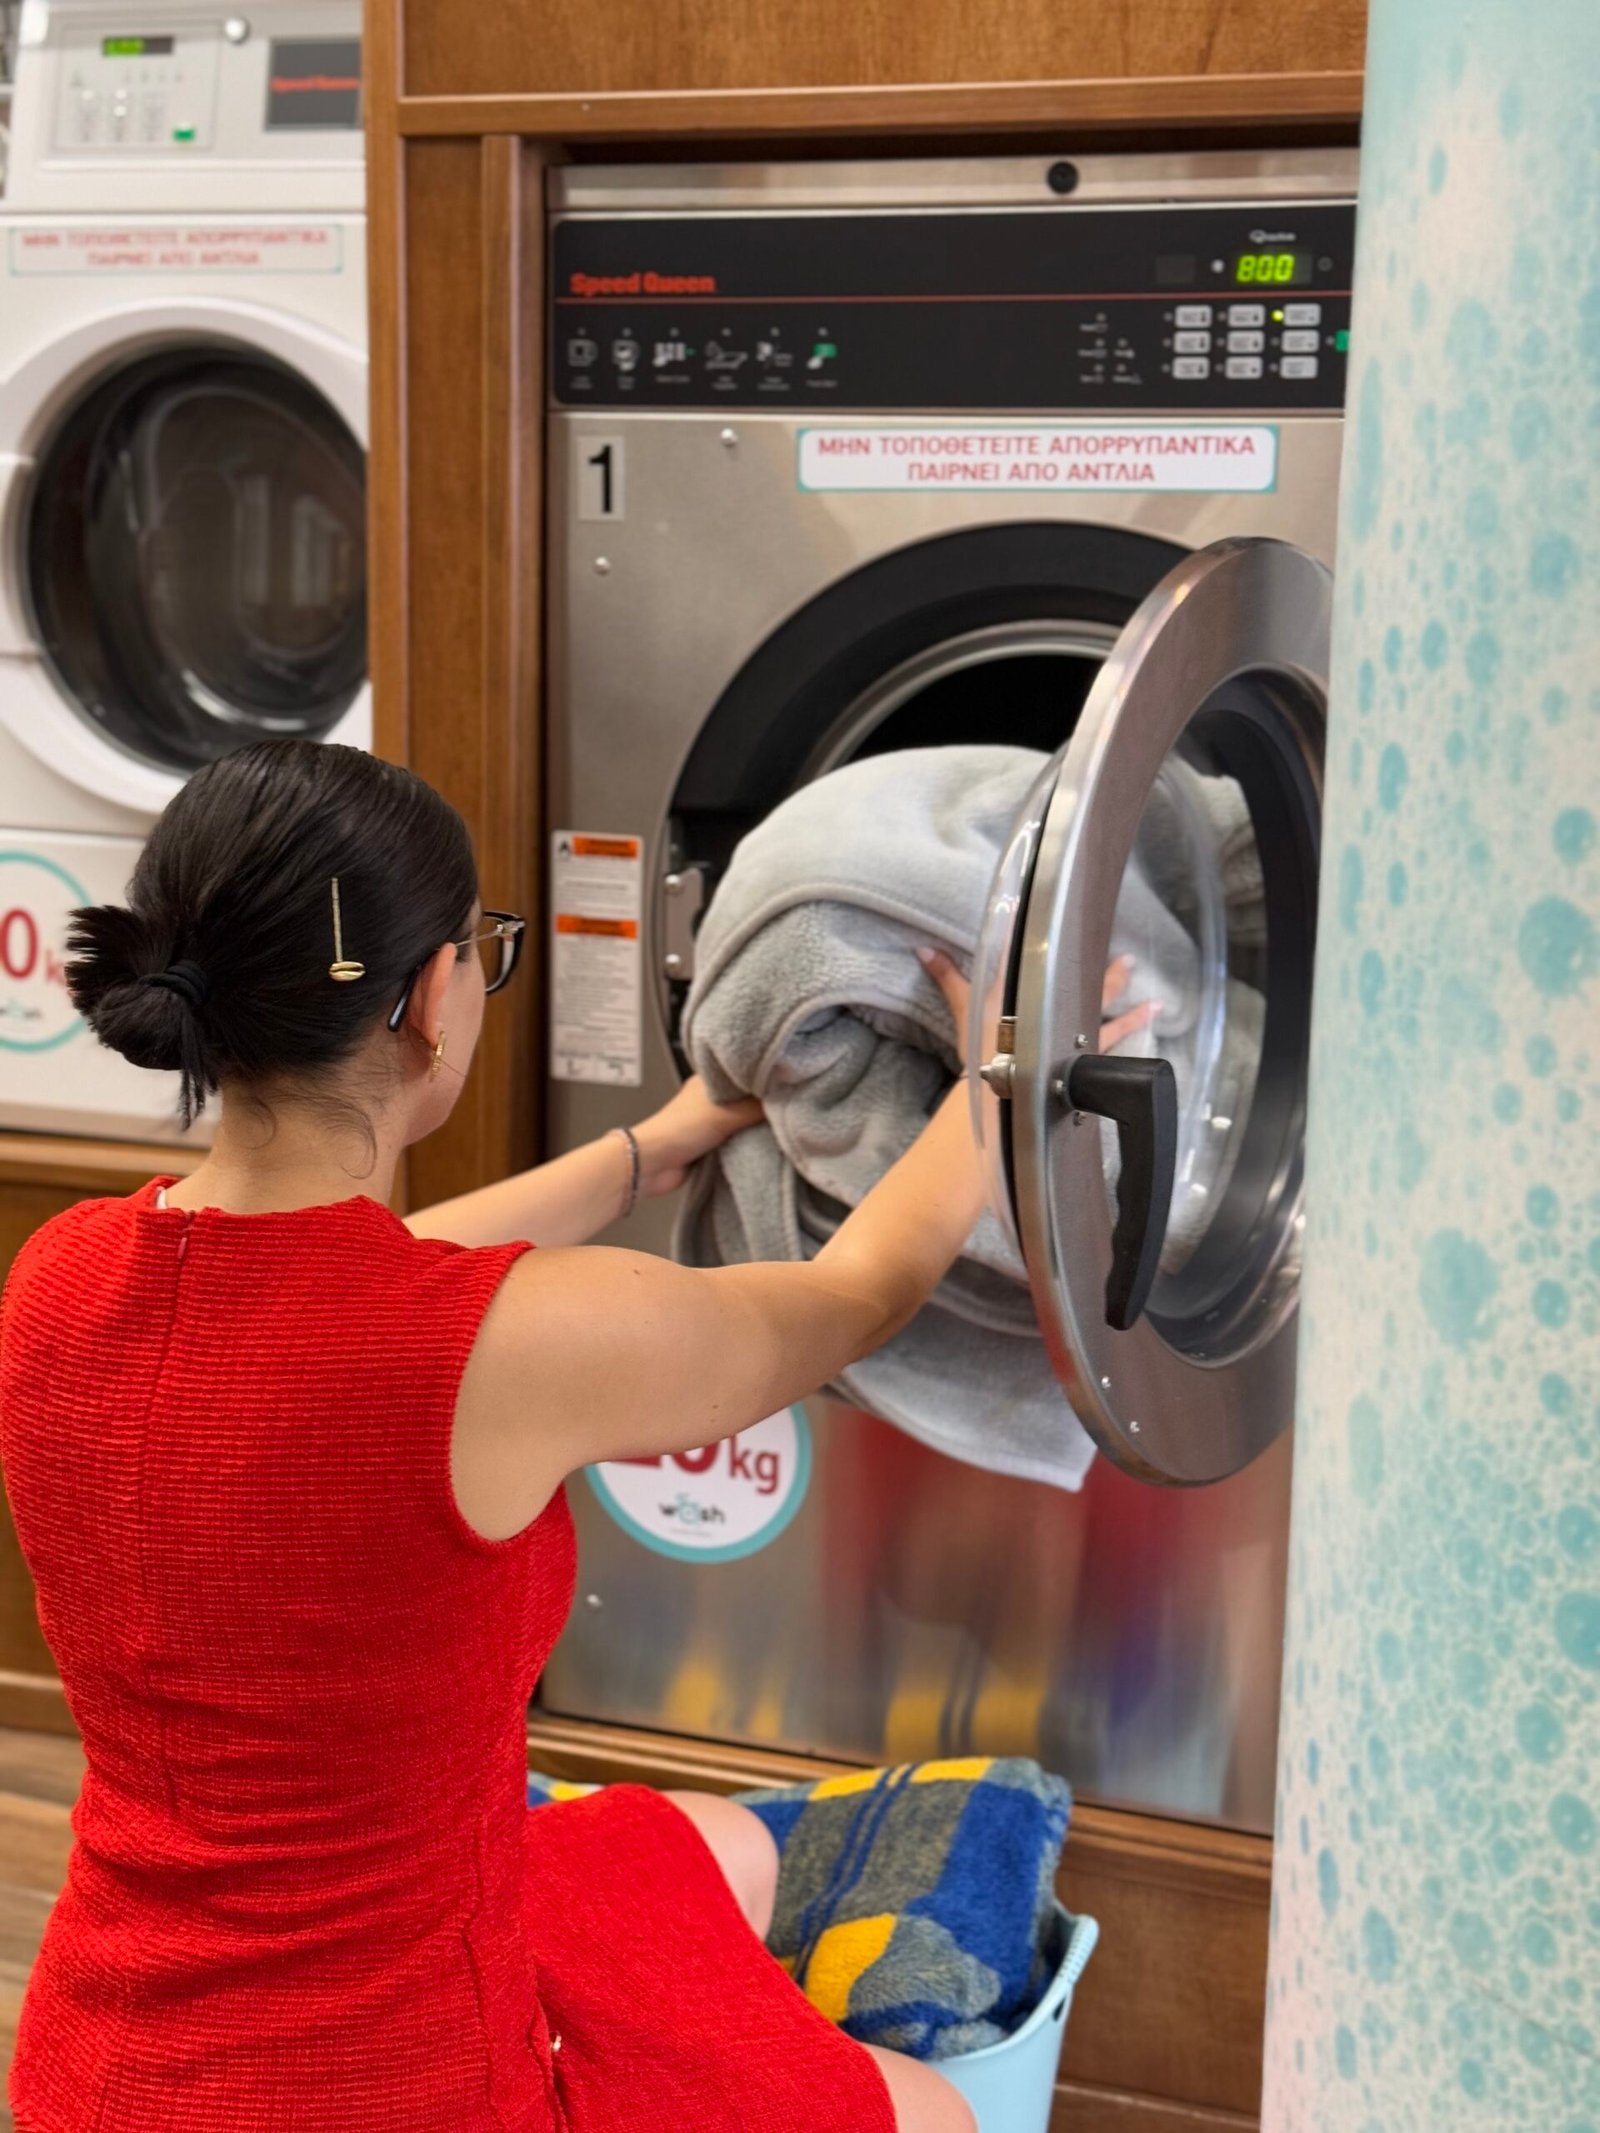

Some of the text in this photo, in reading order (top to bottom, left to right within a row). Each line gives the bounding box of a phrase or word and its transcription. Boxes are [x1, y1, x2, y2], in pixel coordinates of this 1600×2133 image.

[1236, 254, 1295, 283] 800
[570, 272, 641, 297] Speed
[818, 435, 1255, 455] ΜΗΝ ΤΟΠΟΘΕΤΕΙΤΕ ΑΠΟΡΡΥΠΑΝΤΙΚΑ
[587, 444, 612, 513] 1
[907, 461, 1156, 481] ΠΑΙΡΝΕΙ ΑΠΟ ΑΝΤΛΙΑ
